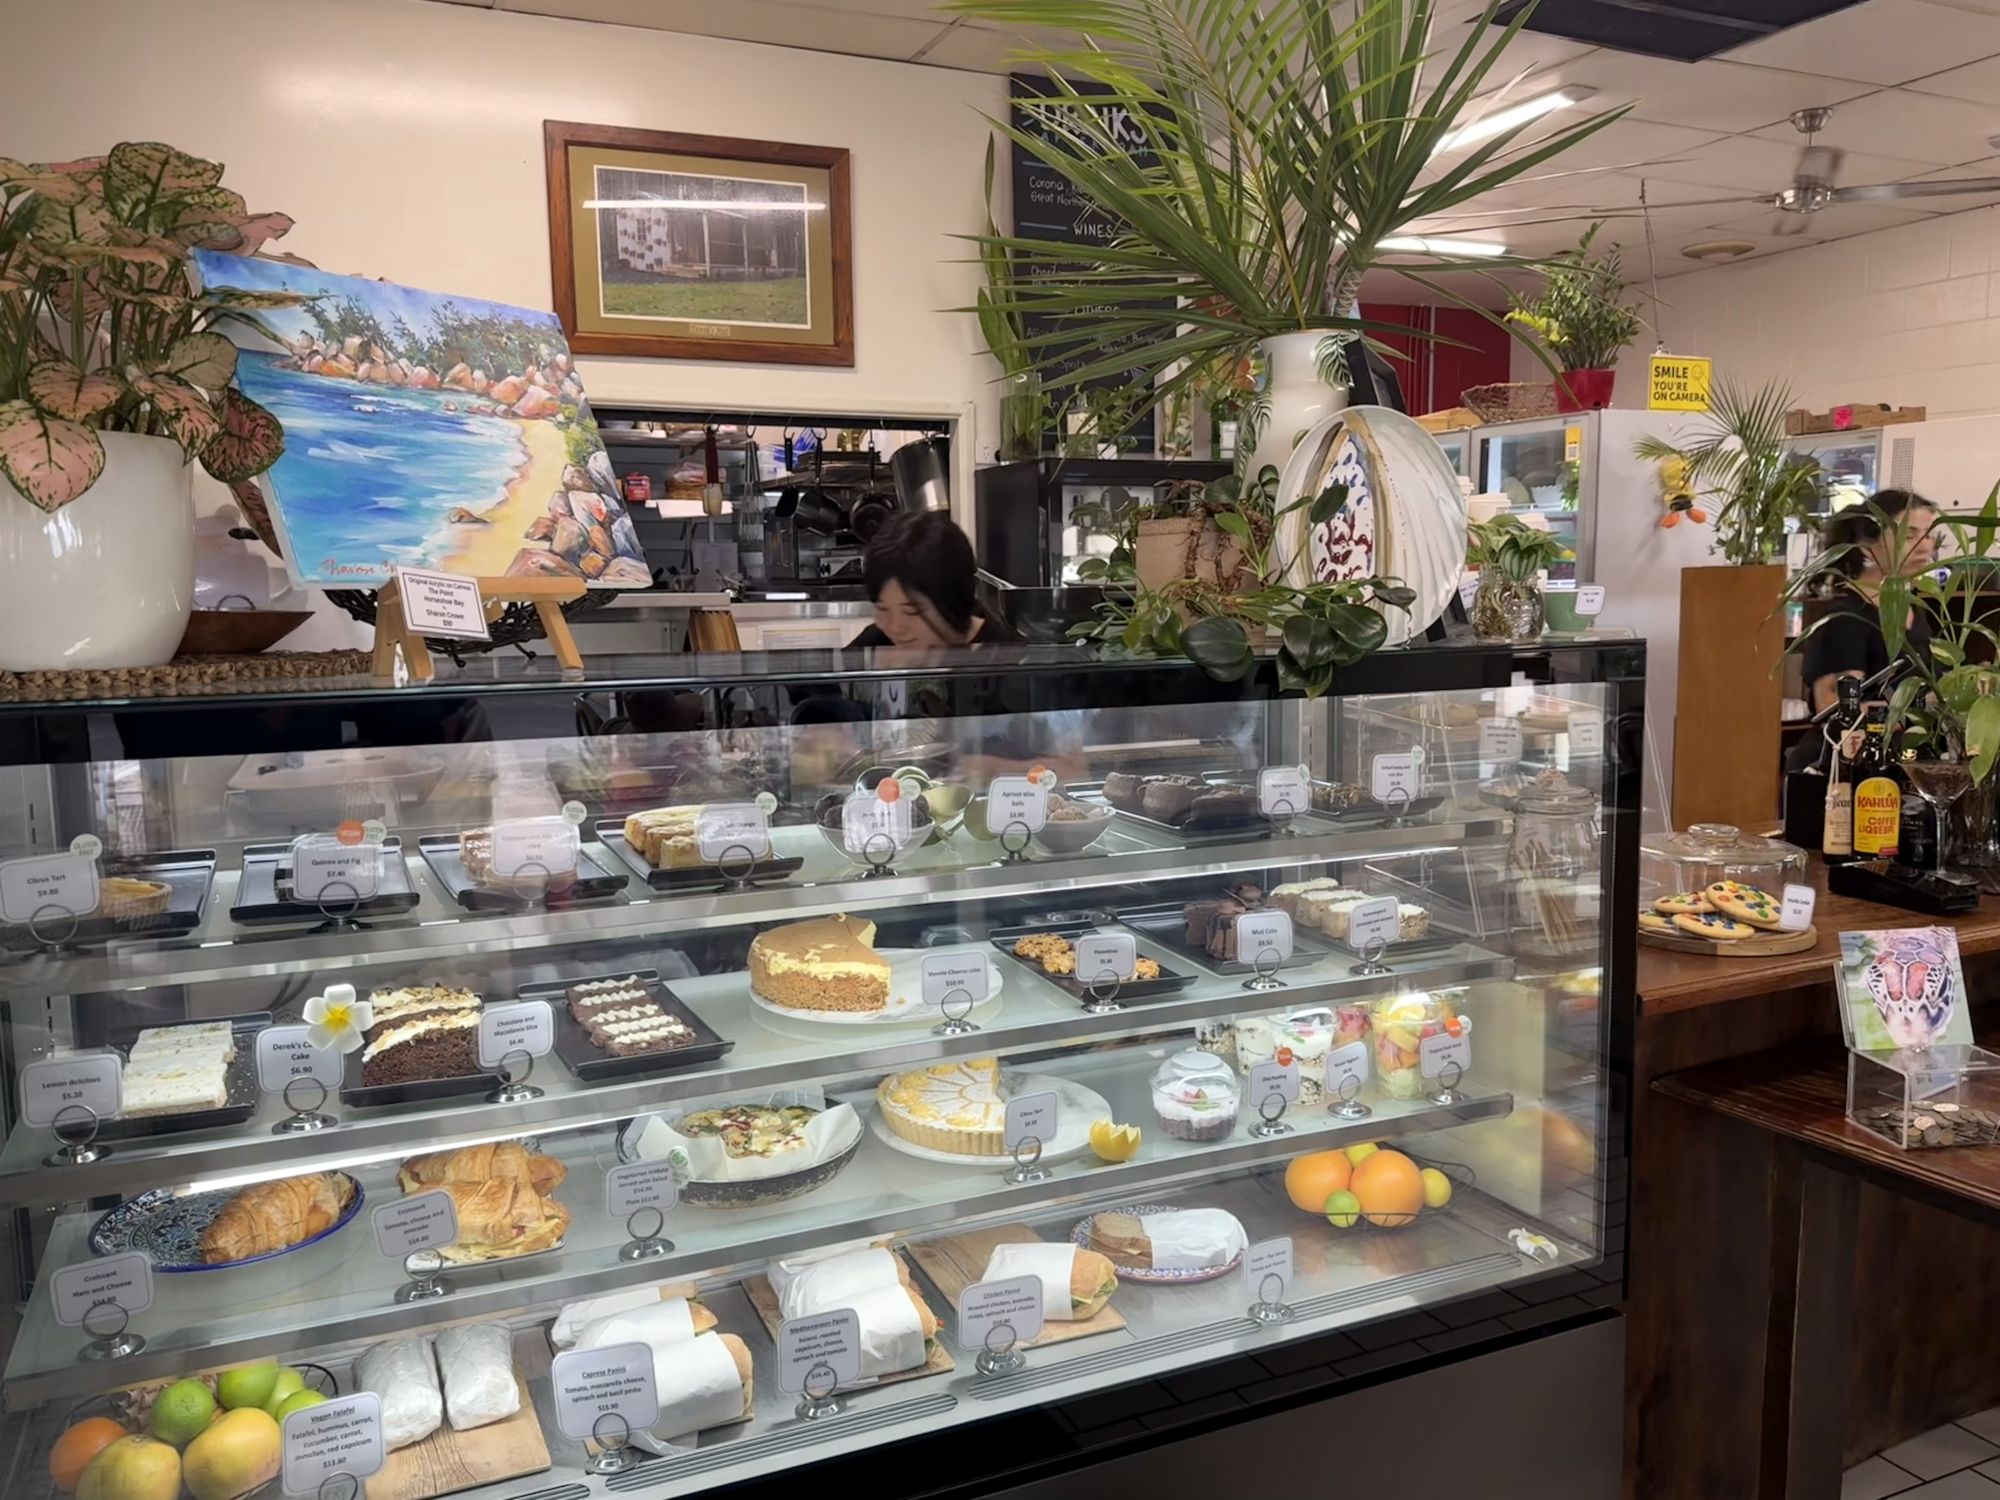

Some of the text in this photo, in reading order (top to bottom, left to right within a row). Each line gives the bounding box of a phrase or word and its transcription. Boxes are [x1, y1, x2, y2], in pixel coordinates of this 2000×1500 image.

[1073, 223, 1114, 238] WINES
[1655, 366, 1688, 379] SMILE
[1654, 381, 1688, 391] YOU'RE
[1653, 392, 1705, 402] ON CAMERA
[424, 596, 453, 605] Horseshoe
[351, 858, 361, 866] Fig
[27, 874, 66, 886] Citrus Tart
[497, 1019, 524, 1028] Chocolate
[494, 1027, 525, 1037] Macadamia
[272, 1042, 302, 1051] Derek's
[291, 1053, 310, 1061] Cake
[291, 1066, 313, 1075] $6.90
[42, 1077, 101, 1089] Lemon delicious
[62, 1091, 84, 1101] $5.20
[397, 1204, 426, 1216] Croissant
[432, 1209, 445, 1218] and
[84, 1271, 118, 1283] Croissant
[73, 1290, 90, 1298] Ham
[107, 1281, 133, 1291] Cheese
[793, 1354, 815, 1363] spinach
[827, 1347, 848, 1356] tomato
[582, 1367, 627, 1380] Caprese Panini
[565, 1376, 647, 1394] Tomato, mozzarella cheese,
[572, 1394, 596, 1404] spinach
[609, 1390, 624, 1398] basil
[624, 1387, 642, 1396] pesto
[311, 1406, 356, 1424] Vegan Falafel
[292, 1417, 374, 1441] Falafel, hummus, carrot,
[304, 1430, 364, 1448] cucumber, carrot,
[328, 1445, 340, 1453] red
[341, 1438, 372, 1451] capsicum
